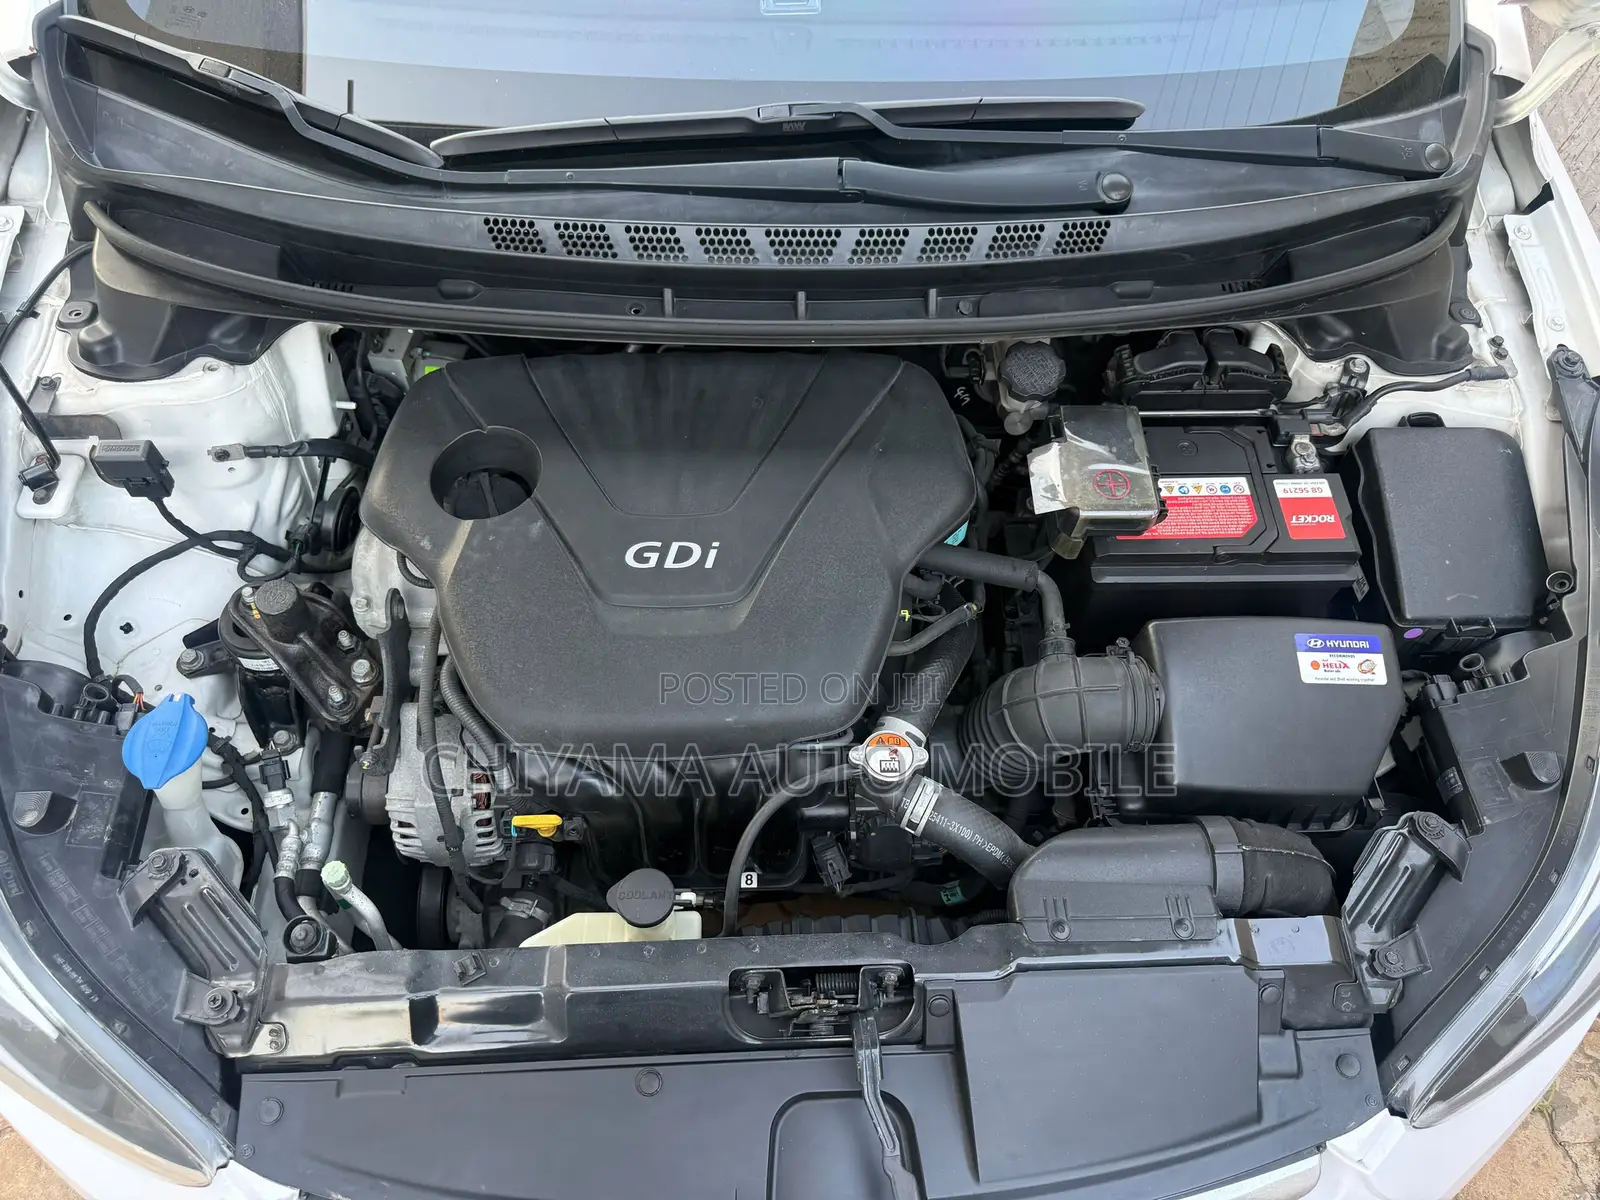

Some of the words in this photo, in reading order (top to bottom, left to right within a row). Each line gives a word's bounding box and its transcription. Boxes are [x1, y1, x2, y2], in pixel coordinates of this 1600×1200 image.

[1290, 514, 1336, 524] ROCKET
[625, 541, 720, 569] GDi
[1326, 640, 1369, 648] HYUNDAI
[745, 873, 754, 886] 8
[618, 888, 674, 901] COOLANT
